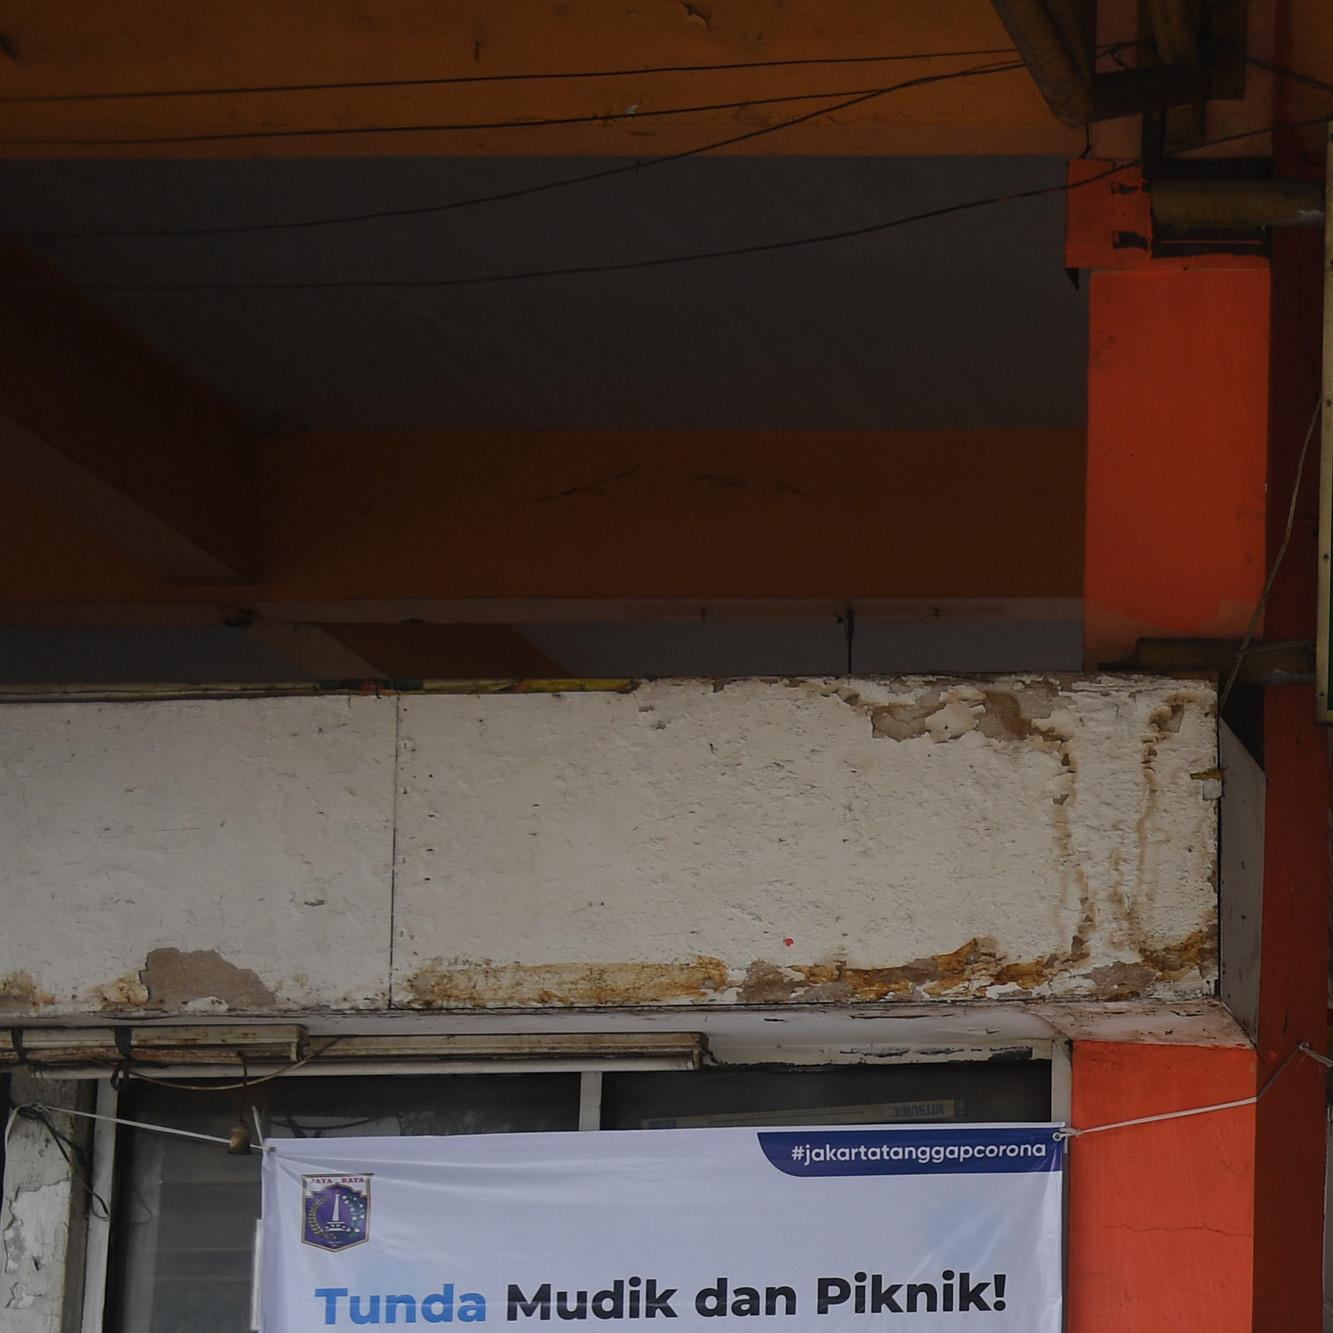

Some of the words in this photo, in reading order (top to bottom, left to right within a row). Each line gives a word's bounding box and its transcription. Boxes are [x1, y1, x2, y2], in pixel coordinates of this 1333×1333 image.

[791, 1140, 1047, 1166] #jakartatanggapcorona
[315, 1283, 487, 1326] Tunda
[507, 1277, 678, 1321] Mudik
[695, 1277, 797, 1316] dan
[817, 1271, 1007, 1316] Piknik!
